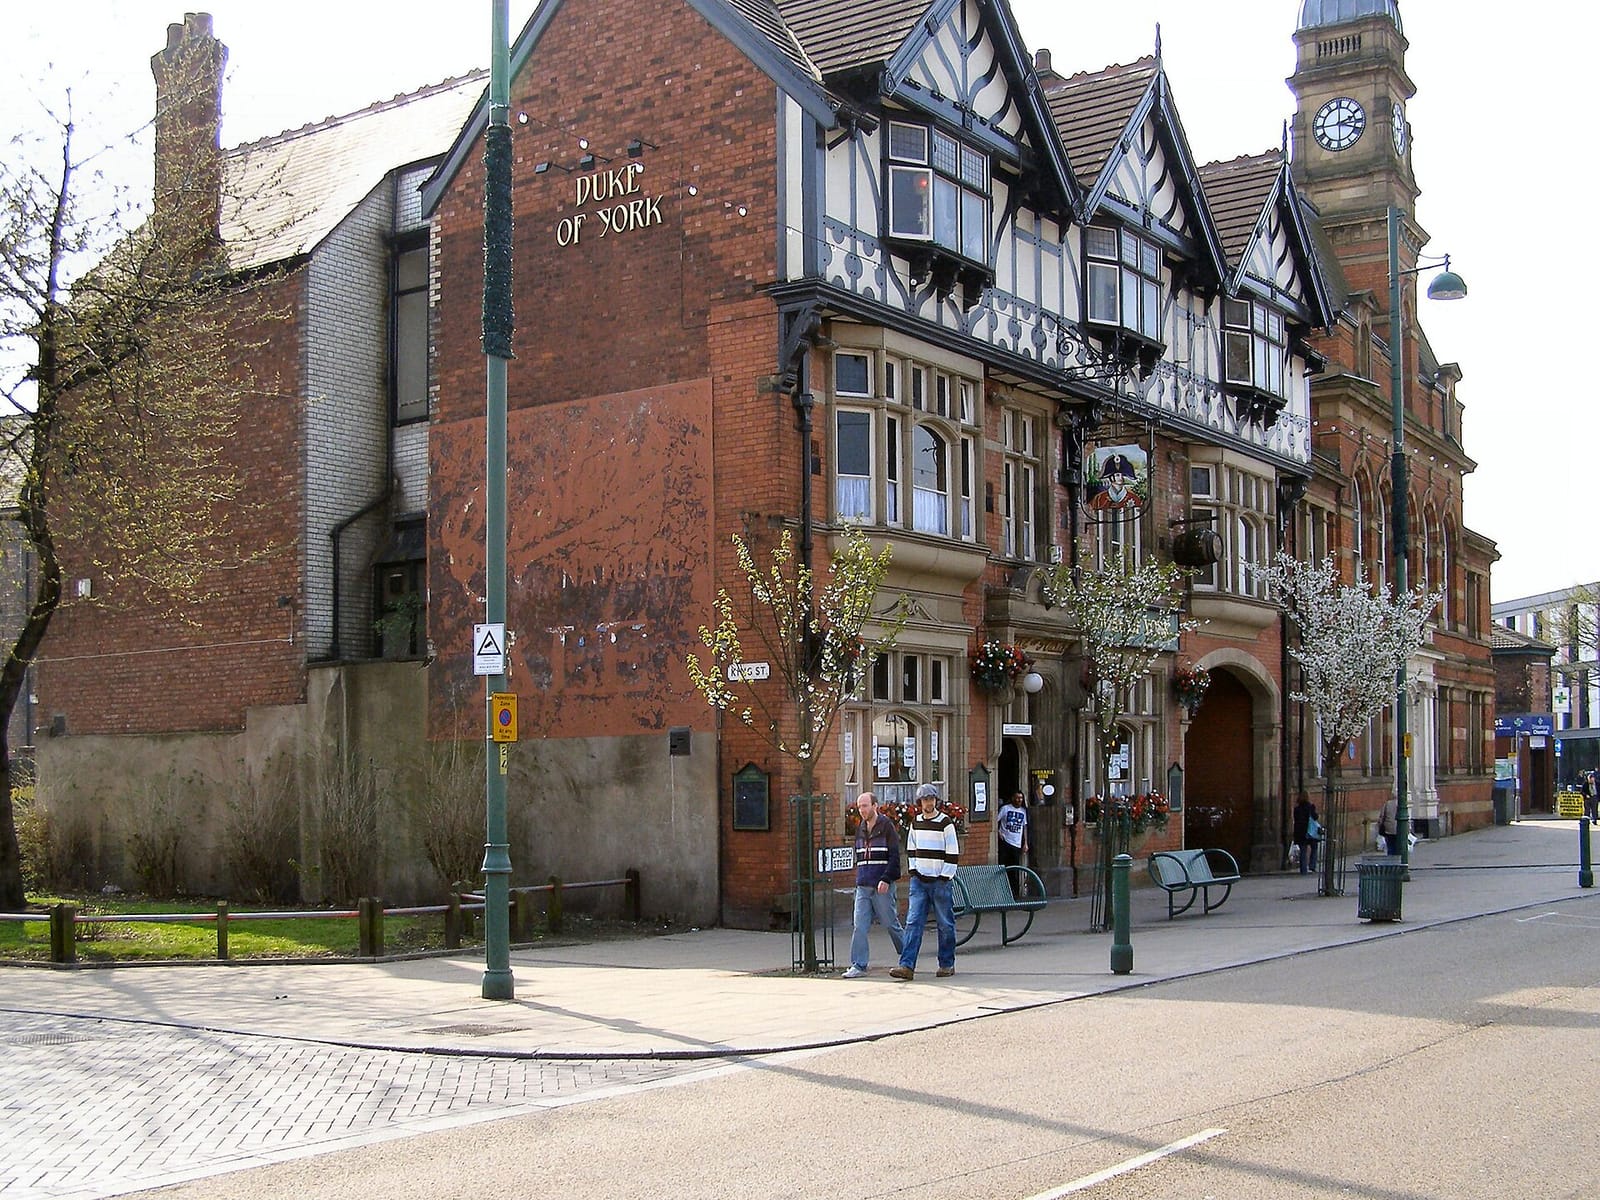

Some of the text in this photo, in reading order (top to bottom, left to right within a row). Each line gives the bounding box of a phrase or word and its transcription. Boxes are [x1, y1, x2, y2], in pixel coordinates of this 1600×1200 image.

[575, 163, 640, 207] DUKE
[556, 194, 663, 247] OF YORK
[832, 850, 852, 858] CHURCH
[833, 859, 852, 868] STREET
